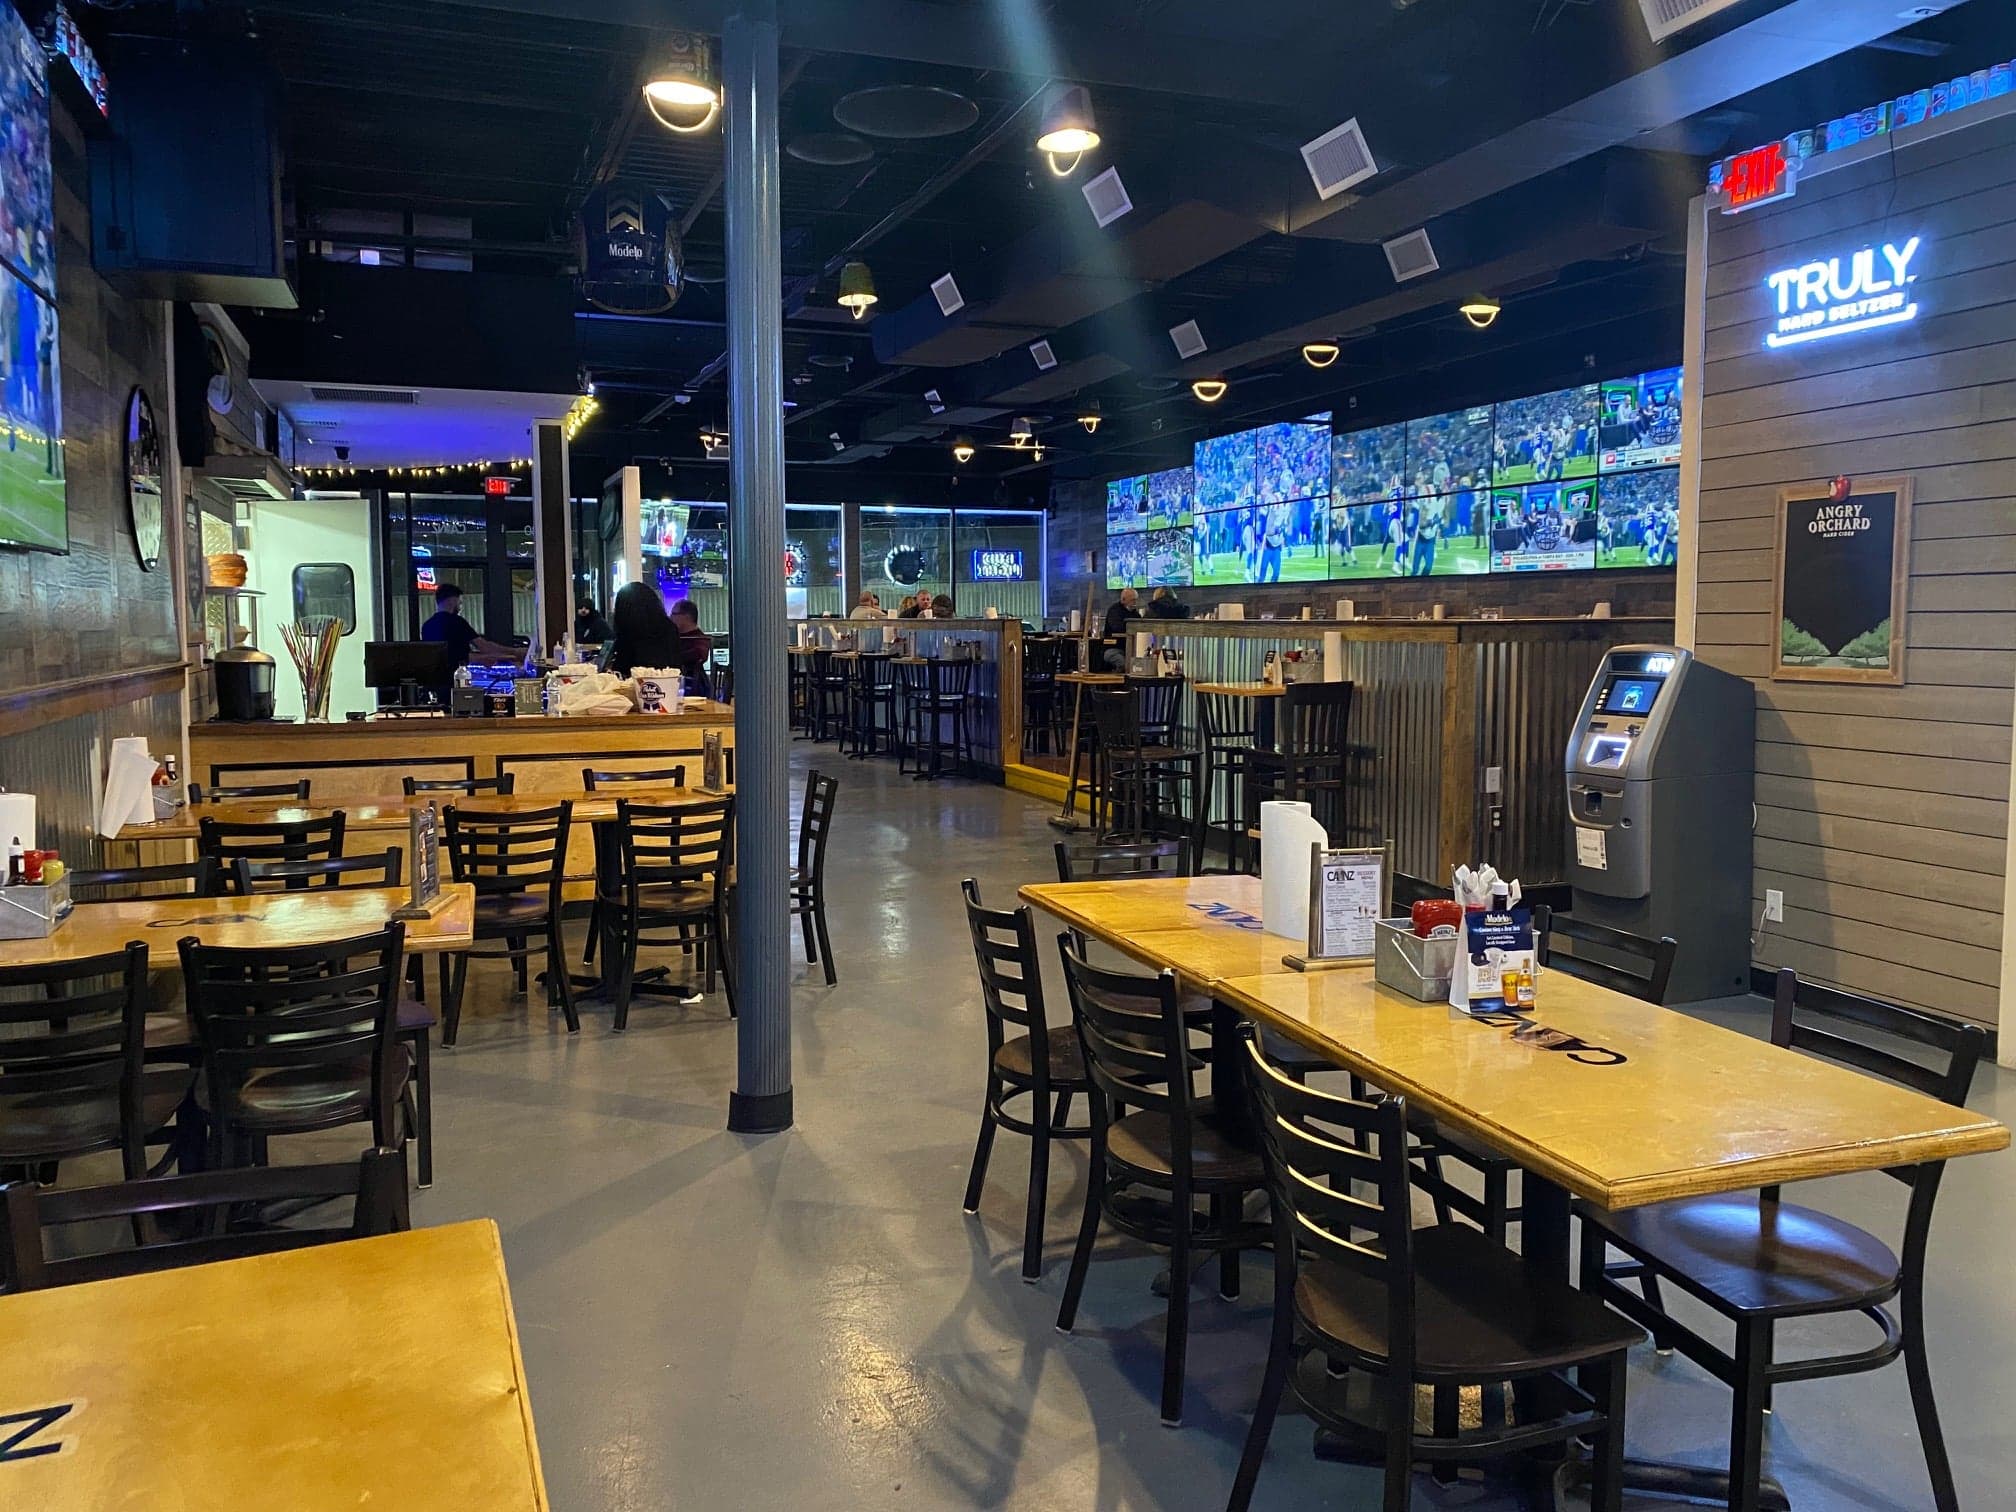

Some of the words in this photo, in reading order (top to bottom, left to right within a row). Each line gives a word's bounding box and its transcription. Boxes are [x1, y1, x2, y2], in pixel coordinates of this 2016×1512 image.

[1730, 143, 1781, 205] EXIT
[608, 243, 643, 258] Modelo
[1768, 236, 1920, 314] TRULY
[1828, 292, 1905, 322] SELTZER
[1816, 504, 1864, 520] ANGRY
[1808, 517, 1871, 534] ORCHARD
[1645, 656, 1676, 673] ATM
